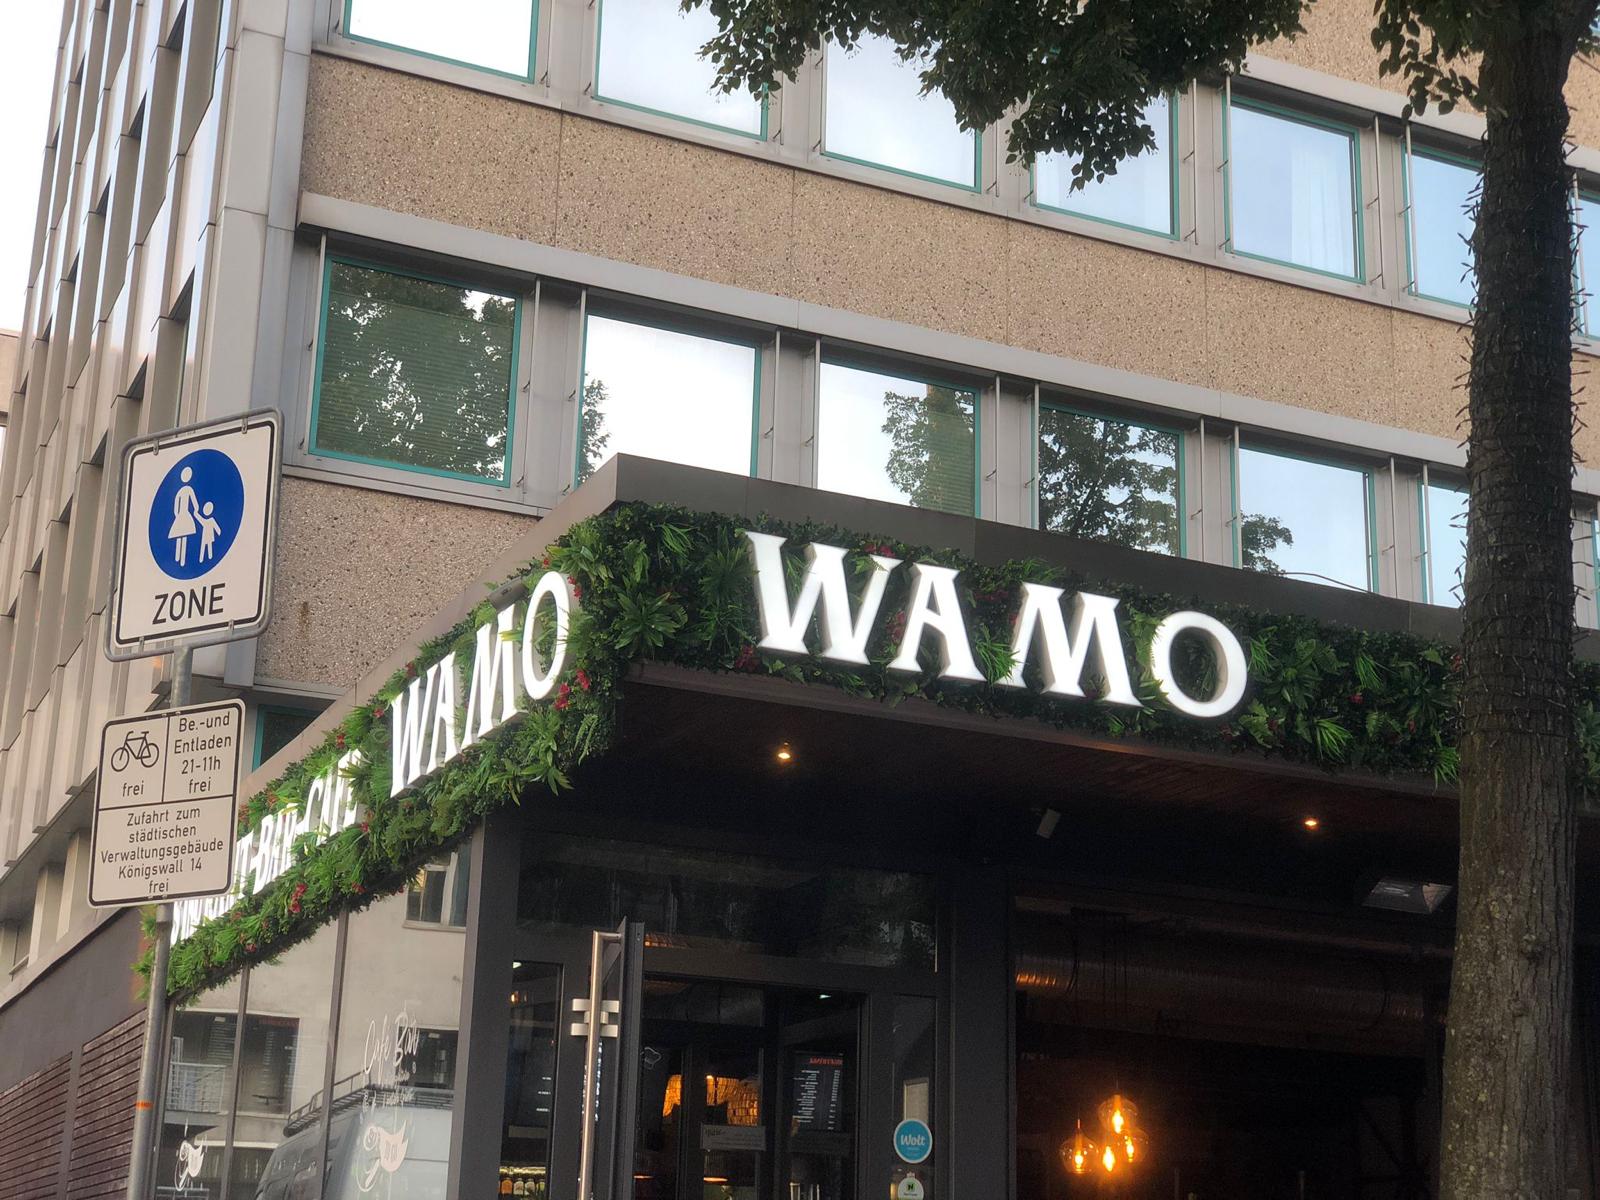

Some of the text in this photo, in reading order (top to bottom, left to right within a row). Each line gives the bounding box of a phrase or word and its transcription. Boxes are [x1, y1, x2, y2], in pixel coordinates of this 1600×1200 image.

[152, 583, 226, 625] ZONE
[747, 530, 1248, 718] WAMO
[390, 571, 570, 799] WAMO
[174, 735, 232, 754] Entladen
[181, 756, 221, 775] 21-11h
[122, 780, 144, 797] frei
[188, 776, 211, 794] frei
[127, 807, 201, 827] Zufahrt zum
[129, 825, 197, 843] städtischen
[101, 838, 224, 864] Verwaltungsgebäude
[118, 857, 202, 880] Königswall 14
[148, 879, 169, 894] frei
[901, 1134, 925, 1146] Wolt
